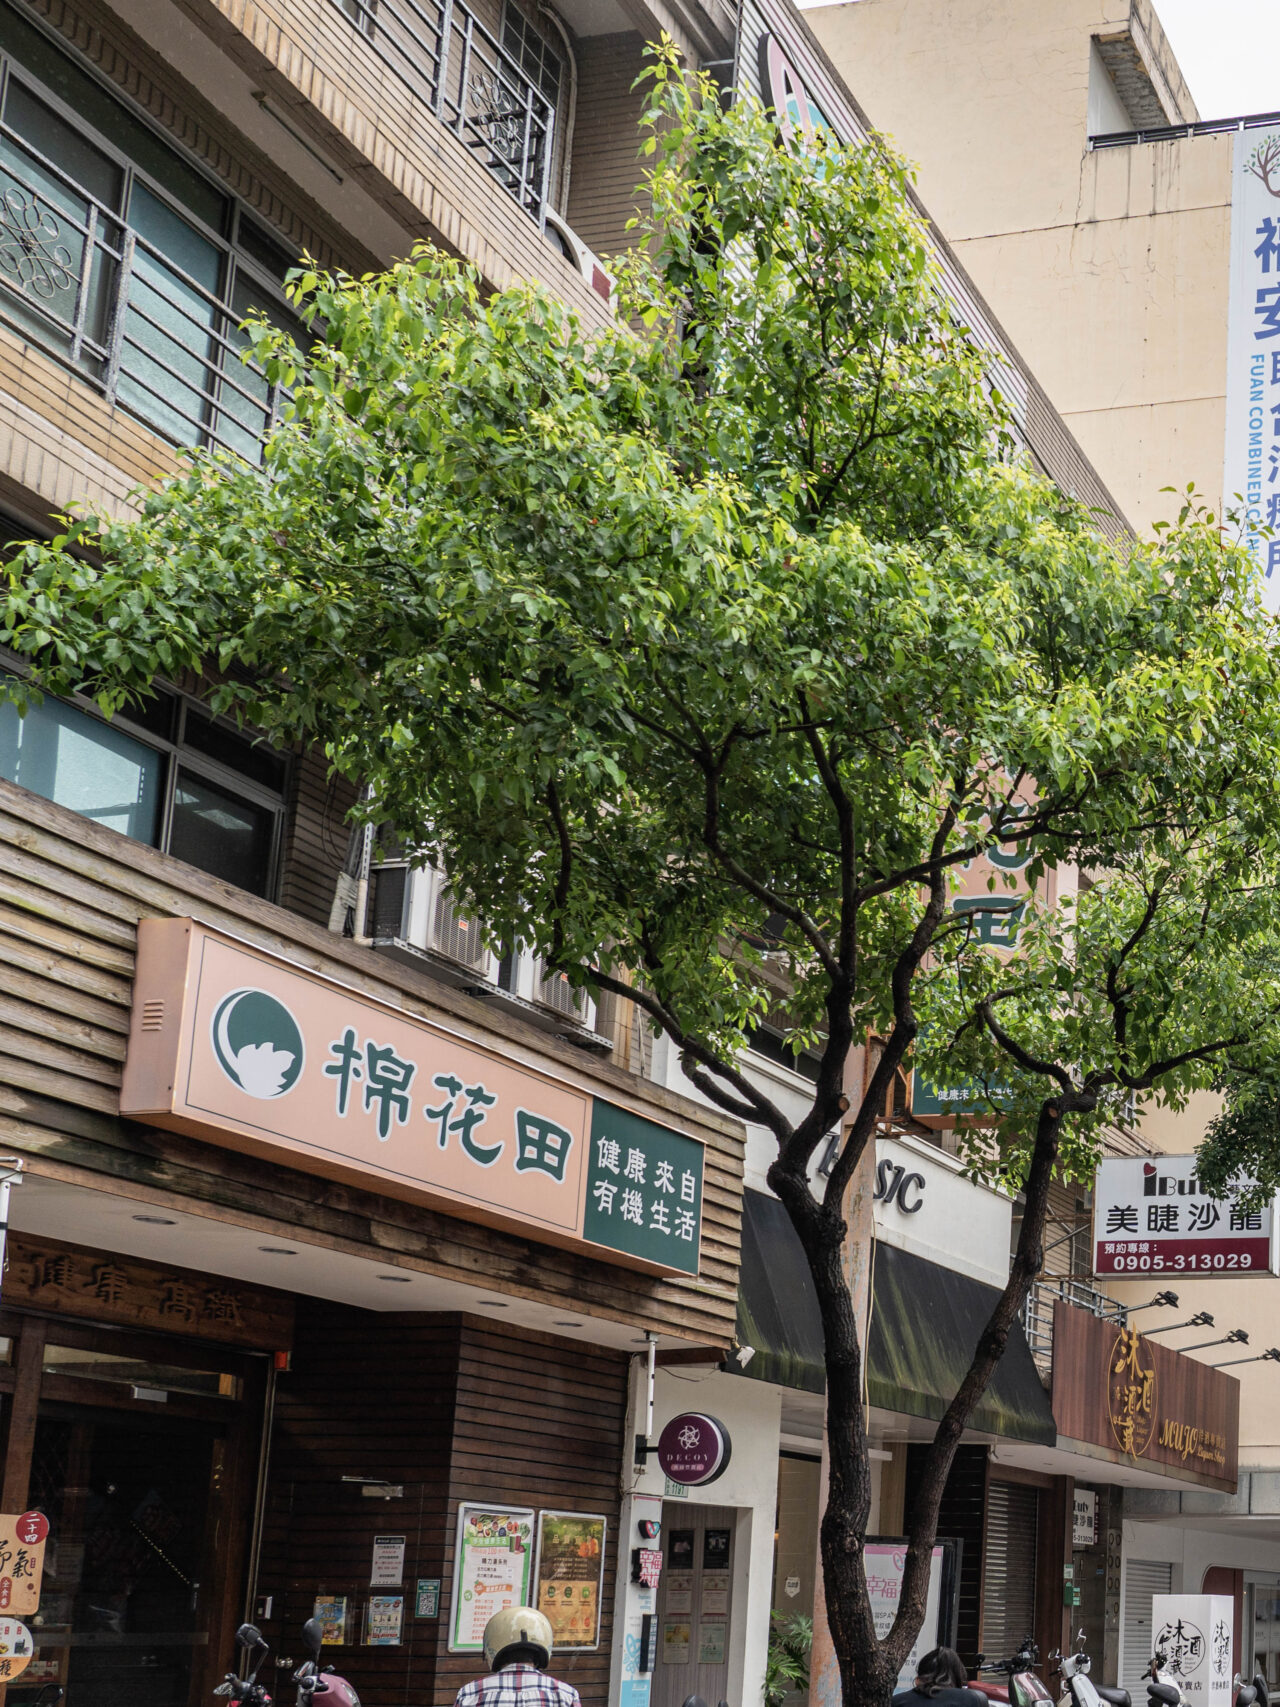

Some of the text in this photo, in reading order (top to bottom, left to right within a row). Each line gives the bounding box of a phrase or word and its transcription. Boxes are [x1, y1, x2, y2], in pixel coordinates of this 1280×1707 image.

[1249, 354, 1265, 402] FUAN
[1247, 406, 1264, 504] COMBINED
[323, 1026, 573, 1184] 棉花田
[596, 1135, 696, 1204] 健康來自
[593, 1179, 697, 1242] 有機生活
[1106, 1203, 1262, 1234] 美睫沙龍
[1113, 1253, 1252, 1271] 0905-313029
[1159, 1418, 1199, 1461] MUJO
[25, 1513, 41, 1543] 二十四
[866, 1574, 904, 1599] 幸福
